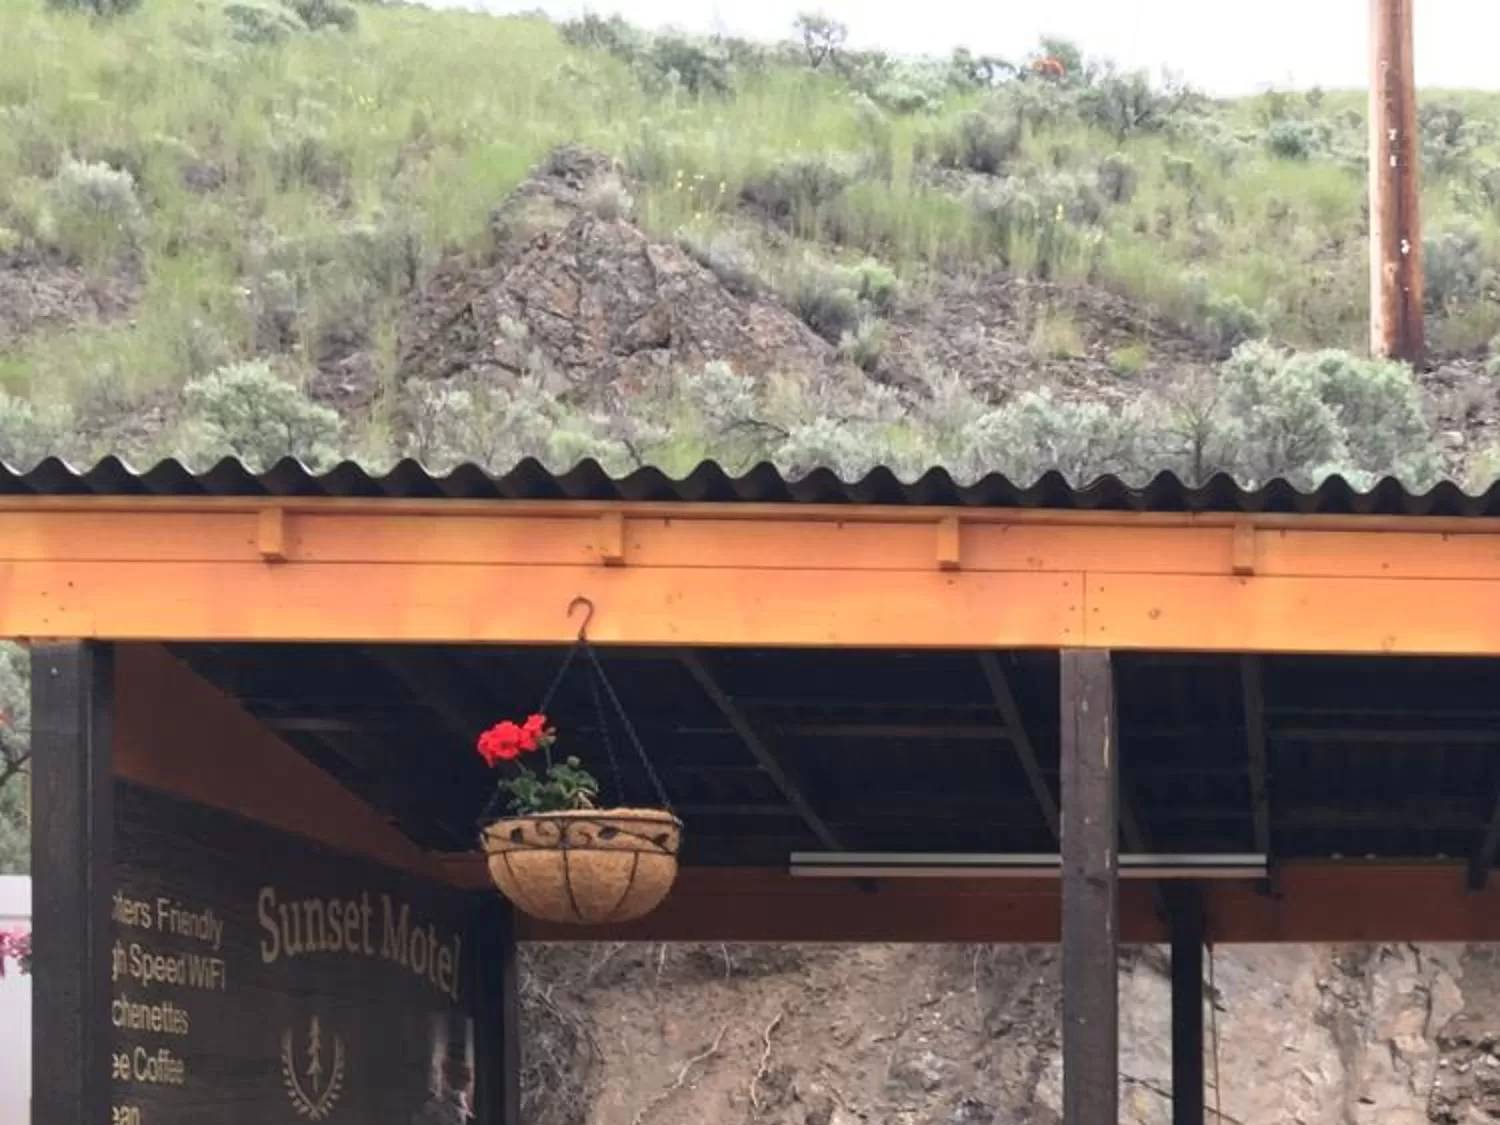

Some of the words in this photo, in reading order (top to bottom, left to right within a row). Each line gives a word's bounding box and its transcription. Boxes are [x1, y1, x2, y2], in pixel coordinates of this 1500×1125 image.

[112, 889, 152, 928] ters
[156, 897, 224, 951] Friendly
[129, 943, 187, 987] Speed
[258, 886, 376, 963] Sunset
[379, 892, 461, 1003] Motel
[112, 992, 189, 1034] chenettes
[132, 1045, 185, 1085] Coffee
